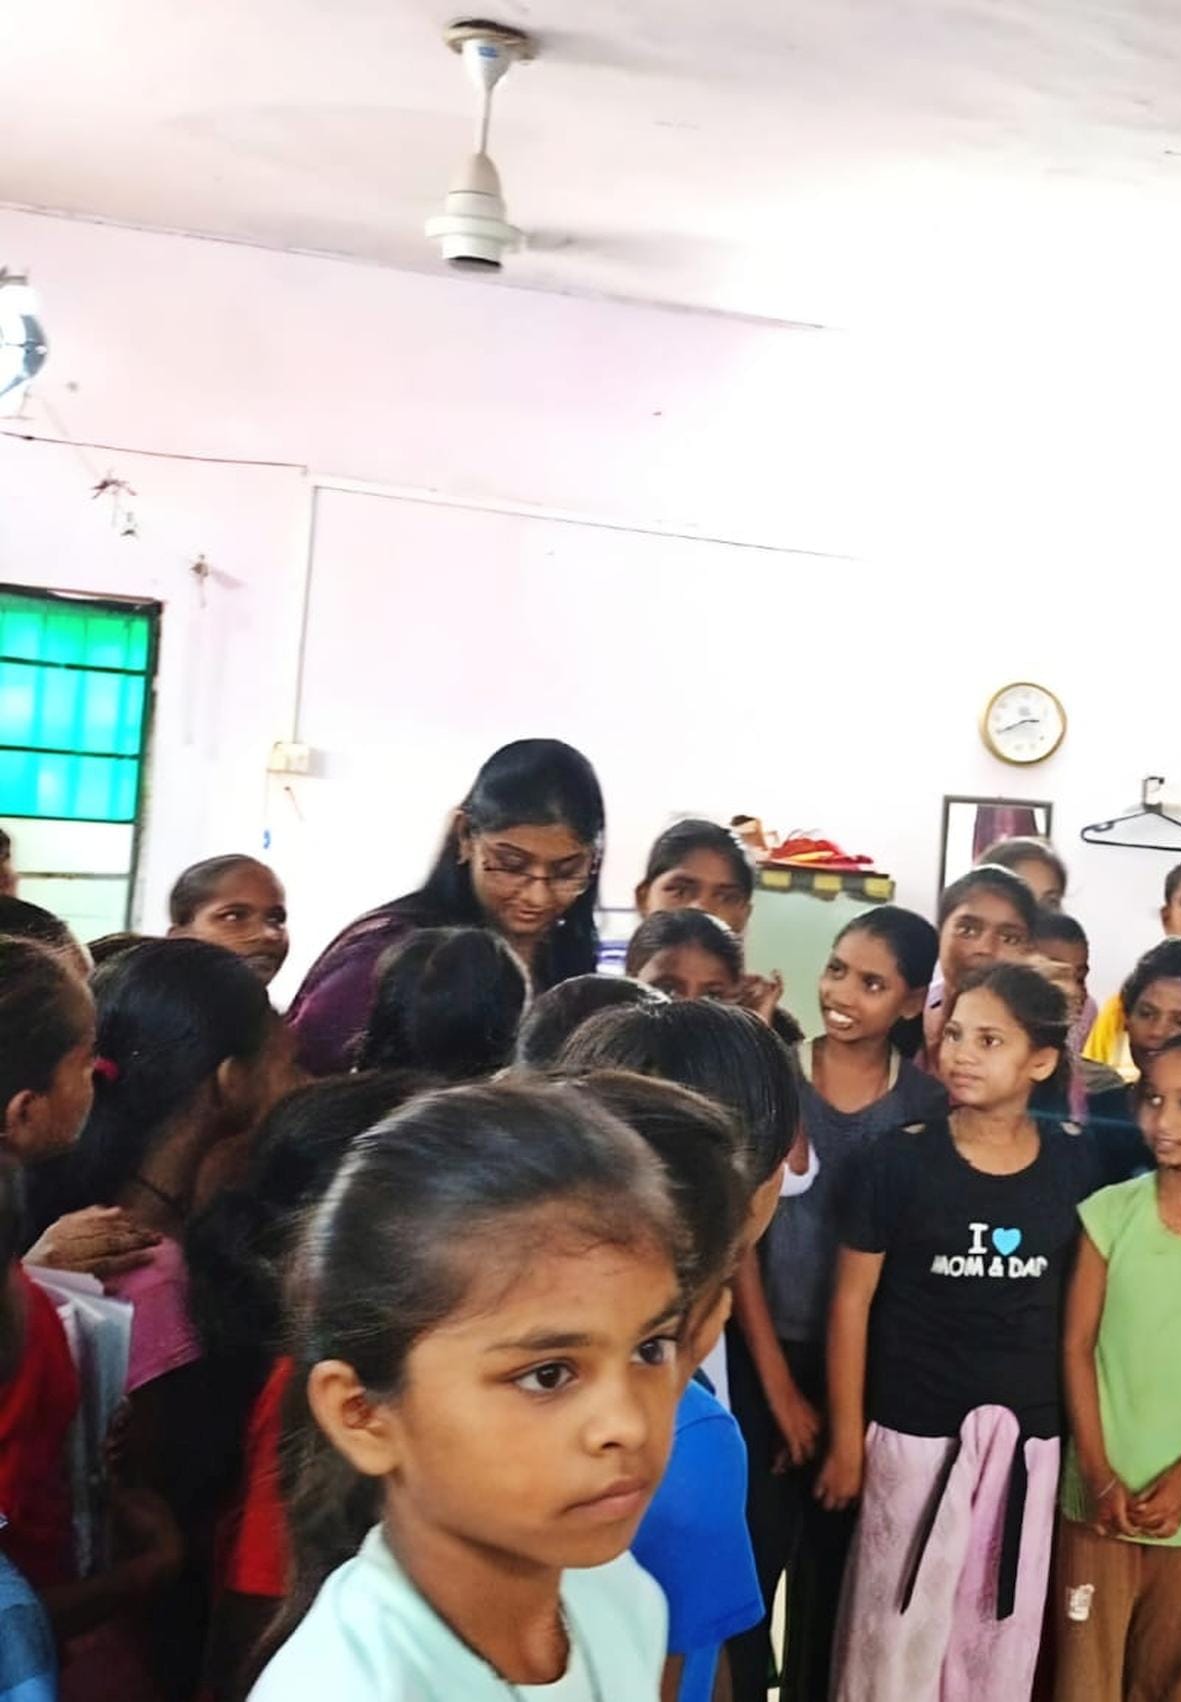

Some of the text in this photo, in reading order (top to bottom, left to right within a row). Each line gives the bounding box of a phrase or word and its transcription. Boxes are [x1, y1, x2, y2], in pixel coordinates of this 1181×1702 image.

[968, 1223, 988, 1254] I
[930, 1255, 984, 1277] MOM
[988, 1256, 1004, 1277] &
